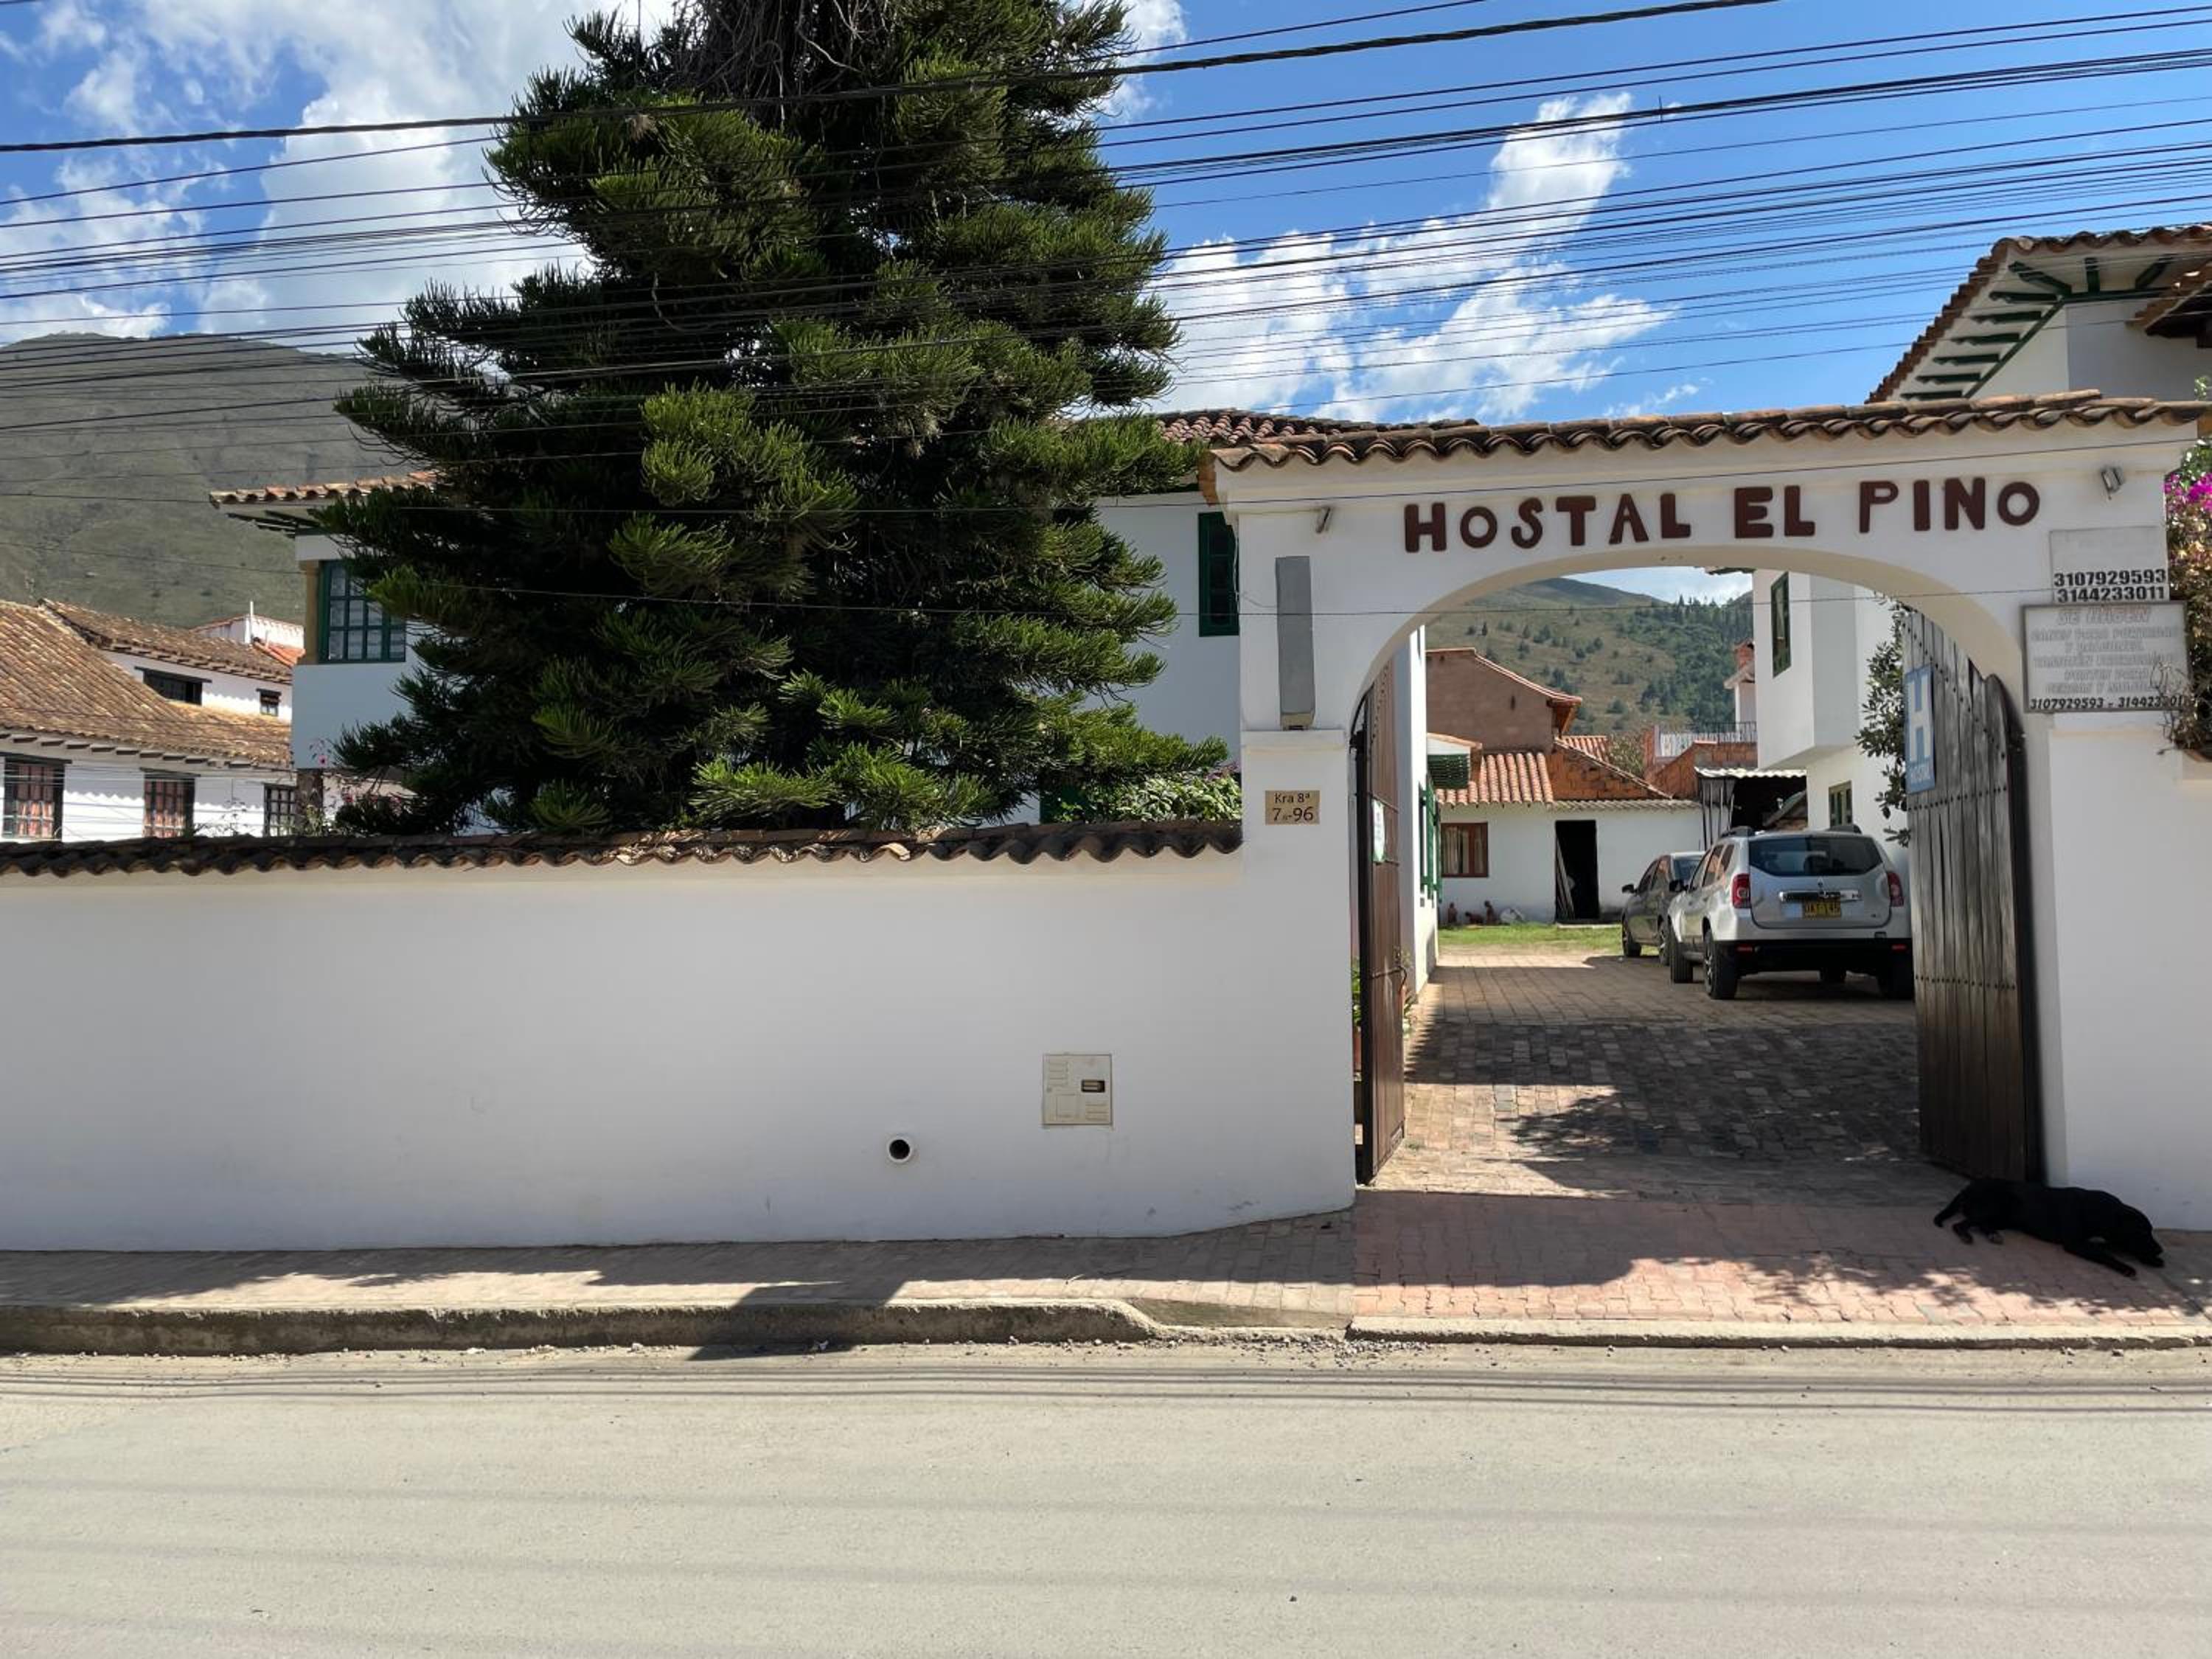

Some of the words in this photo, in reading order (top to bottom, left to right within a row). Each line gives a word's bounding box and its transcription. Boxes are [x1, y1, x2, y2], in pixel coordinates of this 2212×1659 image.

[1404, 493, 1691, 552] HOSTAL
[1734, 485, 1815, 538] EL
[1859, 477, 2040, 533] PINO
[2053, 568, 2166, 587] 3107929593
[2056, 585, 2165, 602] 3144233011
[2030, 698, 2104, 709] 3107929593
[1274, 793, 1294, 803] Kra
